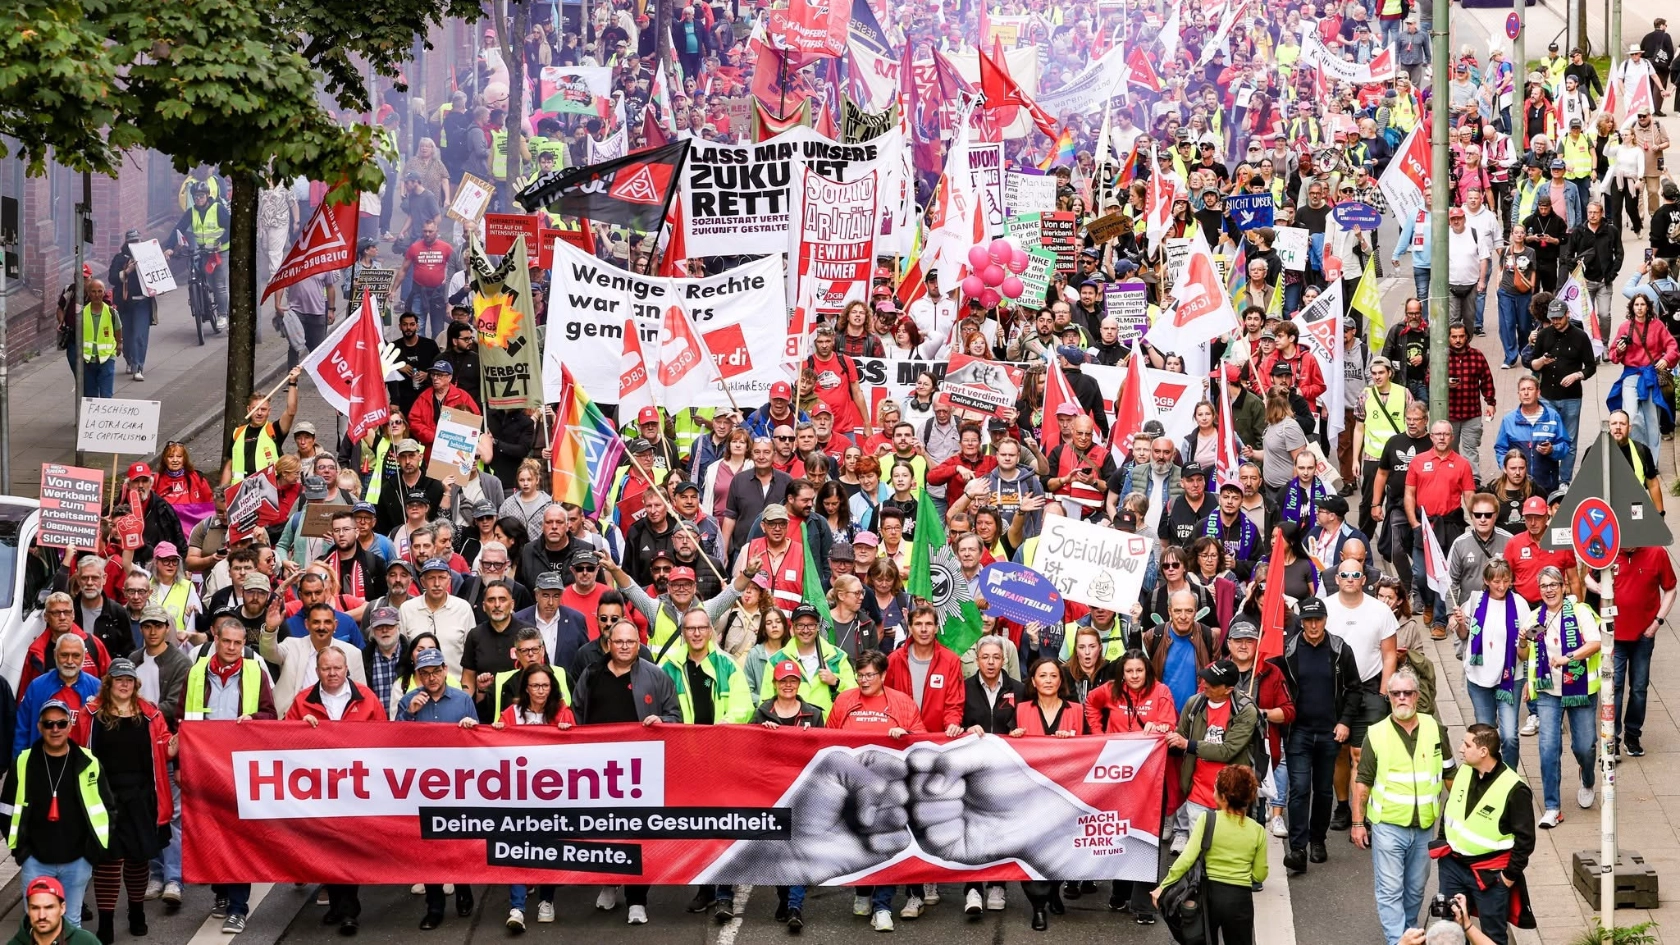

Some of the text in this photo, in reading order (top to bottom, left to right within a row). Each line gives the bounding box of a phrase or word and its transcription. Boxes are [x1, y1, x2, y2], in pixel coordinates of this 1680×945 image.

[690, 145, 749, 165] LASS
[802, 140, 878, 162] UNSERE
[1010, 221, 1040, 232] DANKE
[1043, 220, 1073, 229] Von der
[1027, 254, 1050, 267] ANKE
[685, 273, 766, 300] Rechte
[568, 293, 715, 322] war anrs
[484, 362, 529, 377] VERBOT
[485, 373, 531, 398] TZT
[944, 383, 1010, 406] Hart verdient!
[951, 395, 995, 413] Deine Arbeit.
[85, 419, 144, 430] LA OTRA CARA
[47, 476, 99, 492] Von der
[44, 488, 99, 502] Werkbank
[60, 500, 85, 511] zum
[42, 509, 98, 522] Arbeitsamt
[46, 521, 96, 536] ÜBERNAHME
[43, 533, 95, 547] SICHERN!
[1047, 524, 1139, 574] Sozialabbau
[1044, 557, 1064, 575] ist
[990, 586, 1053, 613] UMFAIRTEILEN
[1564, 620, 1578, 648] alone
[249, 755, 645, 802] Hart verdient!
[1093, 764, 1134, 780] DGB
[432, 813, 782, 834] Deine Arbeit. Deine Gesundheit.
[1078, 813, 1115, 826] MACH
[1084, 822, 1128, 837] DICH
[1074, 837, 1114, 848] STARK
[495, 841, 633, 866] Deine Rente.
